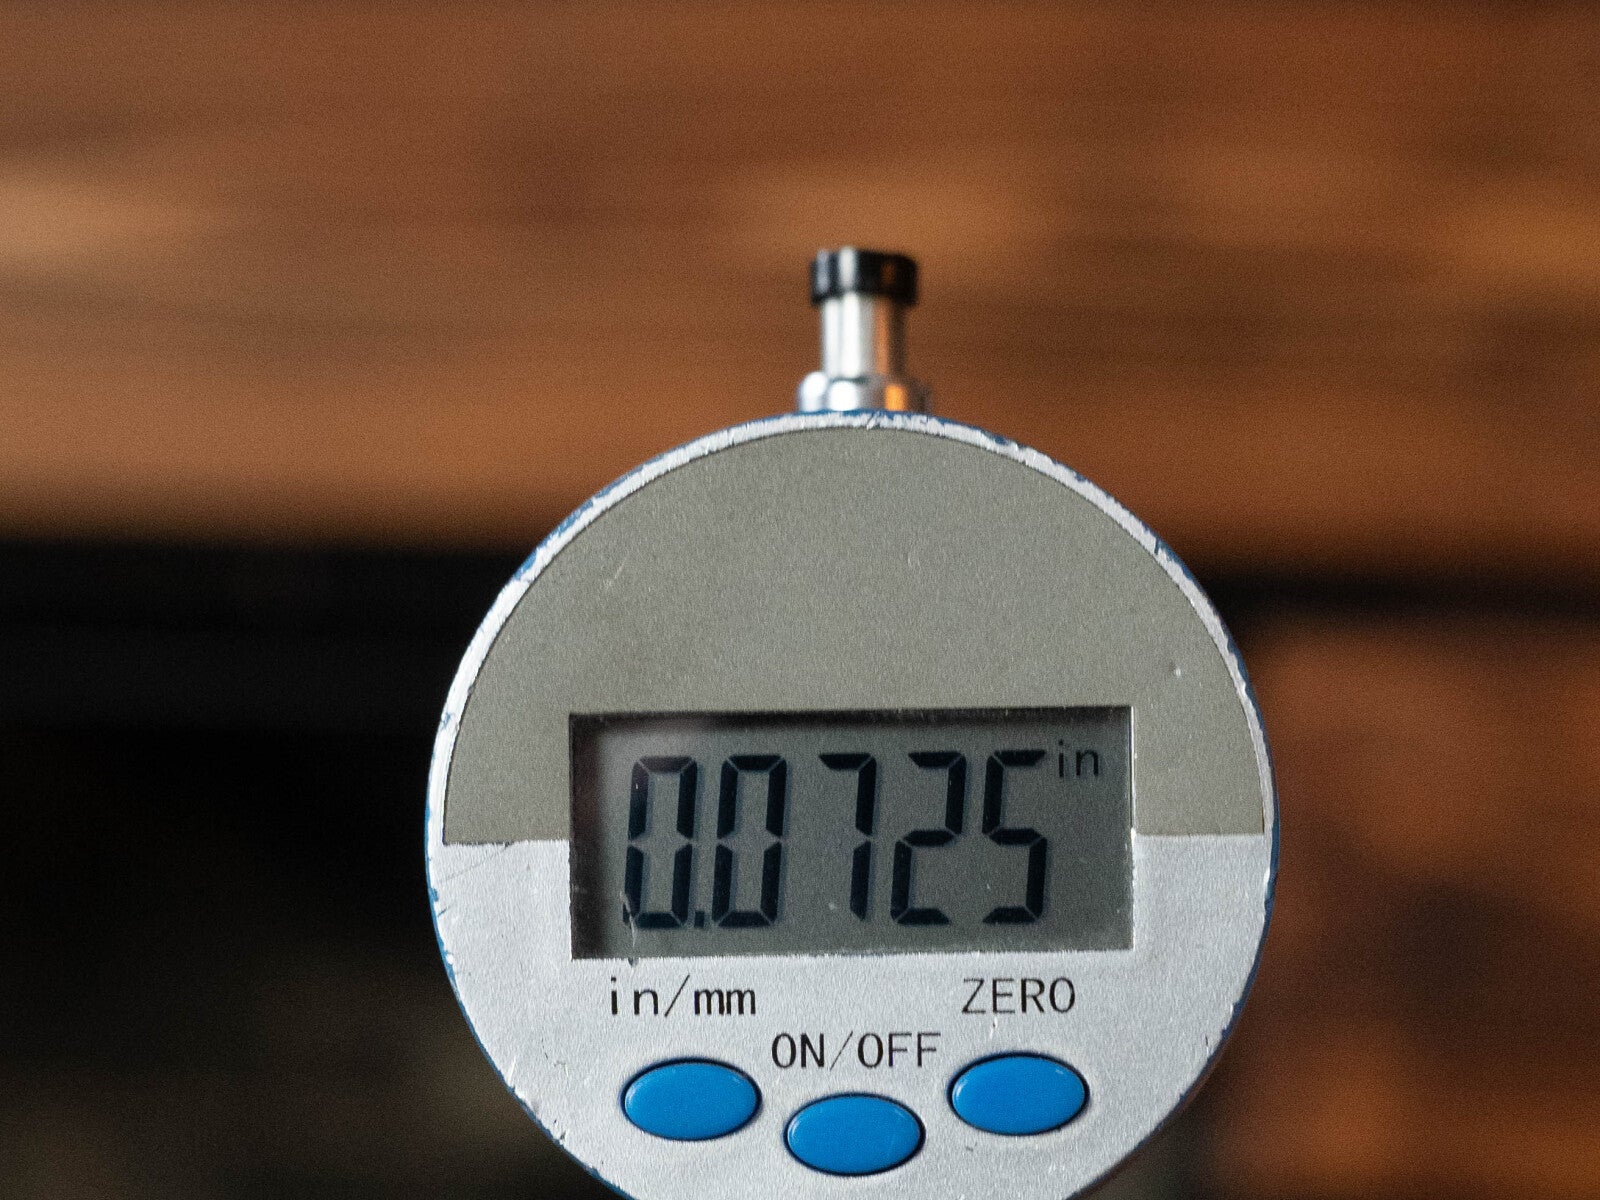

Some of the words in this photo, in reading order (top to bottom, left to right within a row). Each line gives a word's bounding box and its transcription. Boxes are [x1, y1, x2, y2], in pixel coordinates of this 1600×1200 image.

[623, 750, 1049, 930] 0.0725
[1057, 740, 1101, 779] in
[609, 974, 757, 1018] in/mm
[960, 976, 1077, 1016] ZERO
[770, 1030, 942, 1071] ON/OFF
